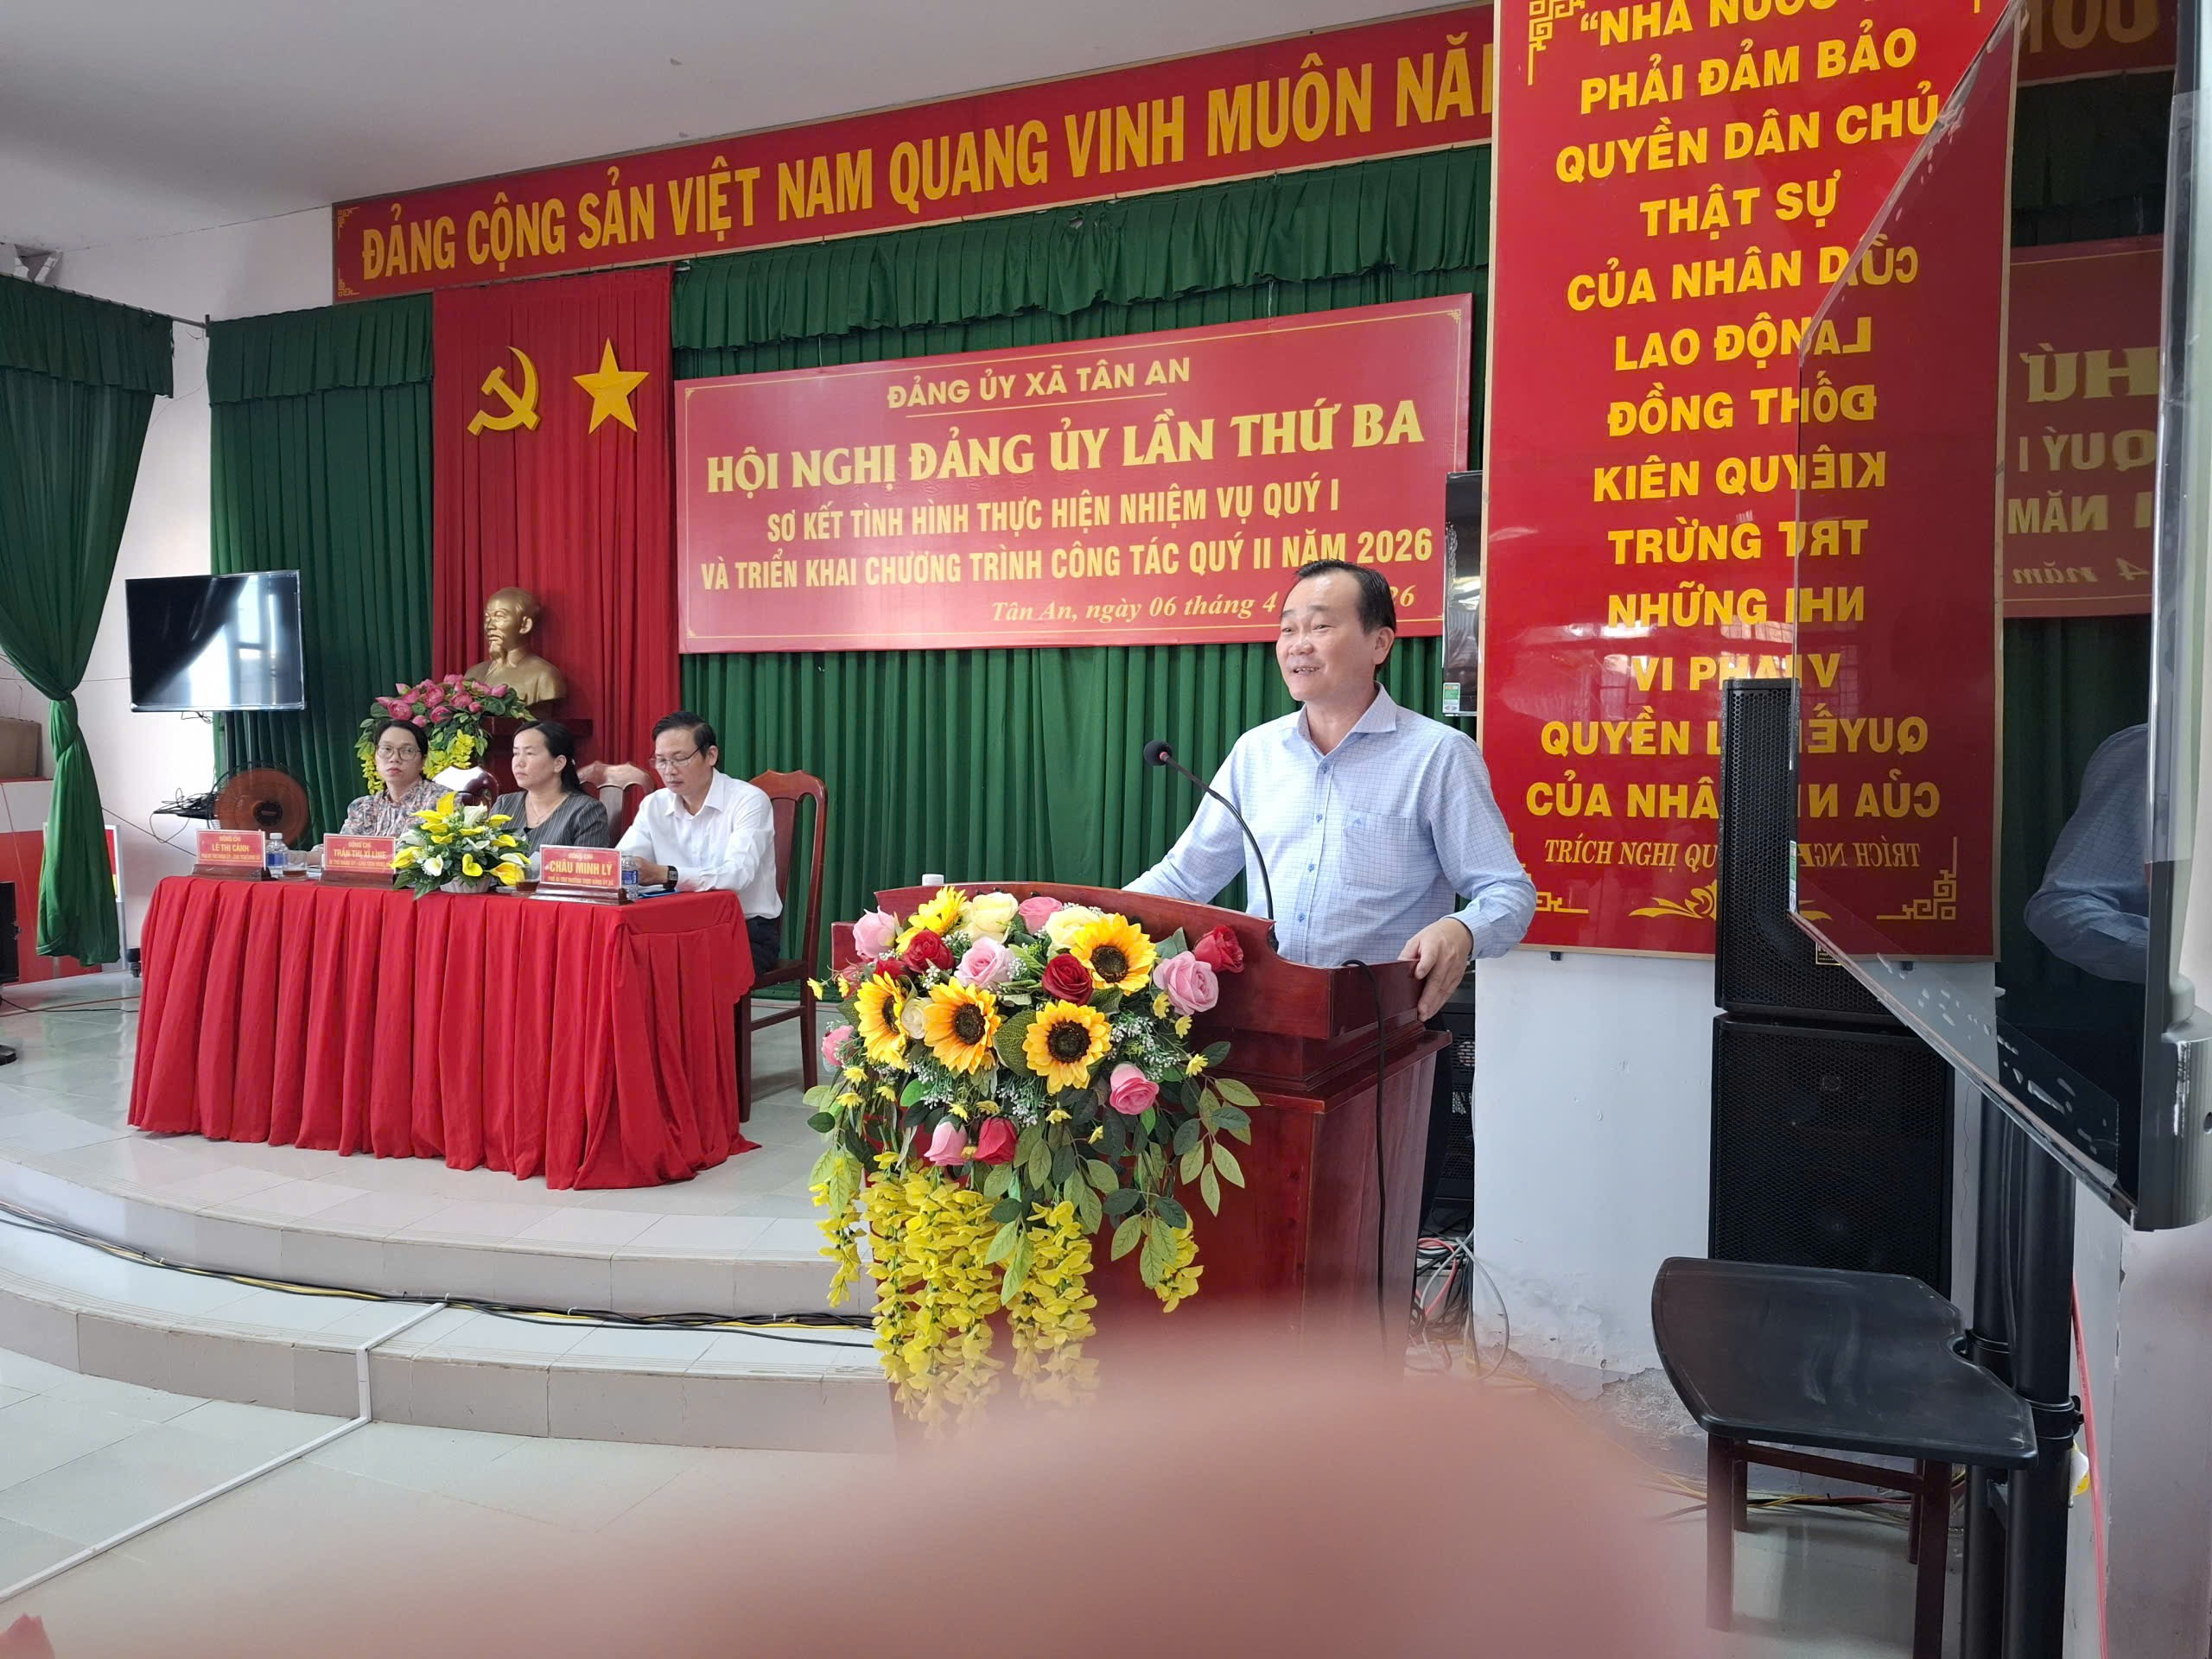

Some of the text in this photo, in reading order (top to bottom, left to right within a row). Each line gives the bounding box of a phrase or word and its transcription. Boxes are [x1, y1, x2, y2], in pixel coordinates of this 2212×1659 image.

[1582, 20, 1916, 113] PHẢI ĐẢM BẢO
[1556, 80, 1939, 182] QUYỀN DÂN CHỦ
[361, 35, 1493, 281] ĐẢNG CỘNG SẢN VIỆT NAM QUANG VINH MUÔN NĂ
[1641, 169, 1841, 239] THẬT SỰ
[1567, 258, 1656, 311] CỦA
[1672, 246, 1802, 299] NHÂN
[1616, 312, 1812, 371] LAO ĐỘN
[888, 359, 1190, 408] ĐẢNG ỦY XÃ TÂN AN
[1608, 383, 1800, 436] ĐỒNG TH
[708, 398, 1424, 498] HỘI NGHỊ ĐẢNG ỦY LẦN THỨ BA
[1594, 454, 1799, 502] KIÊN QUY
[767, 473, 1340, 543] SƠ KẾT TÌNH HÌNH THỰC HIỆN NHIỆM VỤ QUÝ I
[702, 528, 1433, 589] VÀ TRIỂN KHAI CHƯƠNG TRÌNH CÔNG TÁC QUÝ II NĂM 2026
[1609, 517, 1761, 564] TRỪNG
[994, 601, 1035, 622] Tân
[1045, 603, 1078, 621] An,
[1086, 599, 1143, 623] ngày
[1147, 598, 1179, 617] 06
[1184, 595, 1255, 620] tháng
[1262, 592, 1279, 613] 4
[1607, 581, 1767, 629] NHỮNG
[1632, 658, 1672, 691] VI
[1541, 705, 1690, 755] QUYỀN
[1527, 771, 1719, 818] CỦA NHÂ
[550, 859, 613, 875] CHÂU MINH LÝ
[1546, 836, 1615, 866] TRÍCH
[1618, 842, 1680, 871] NGHỊ
